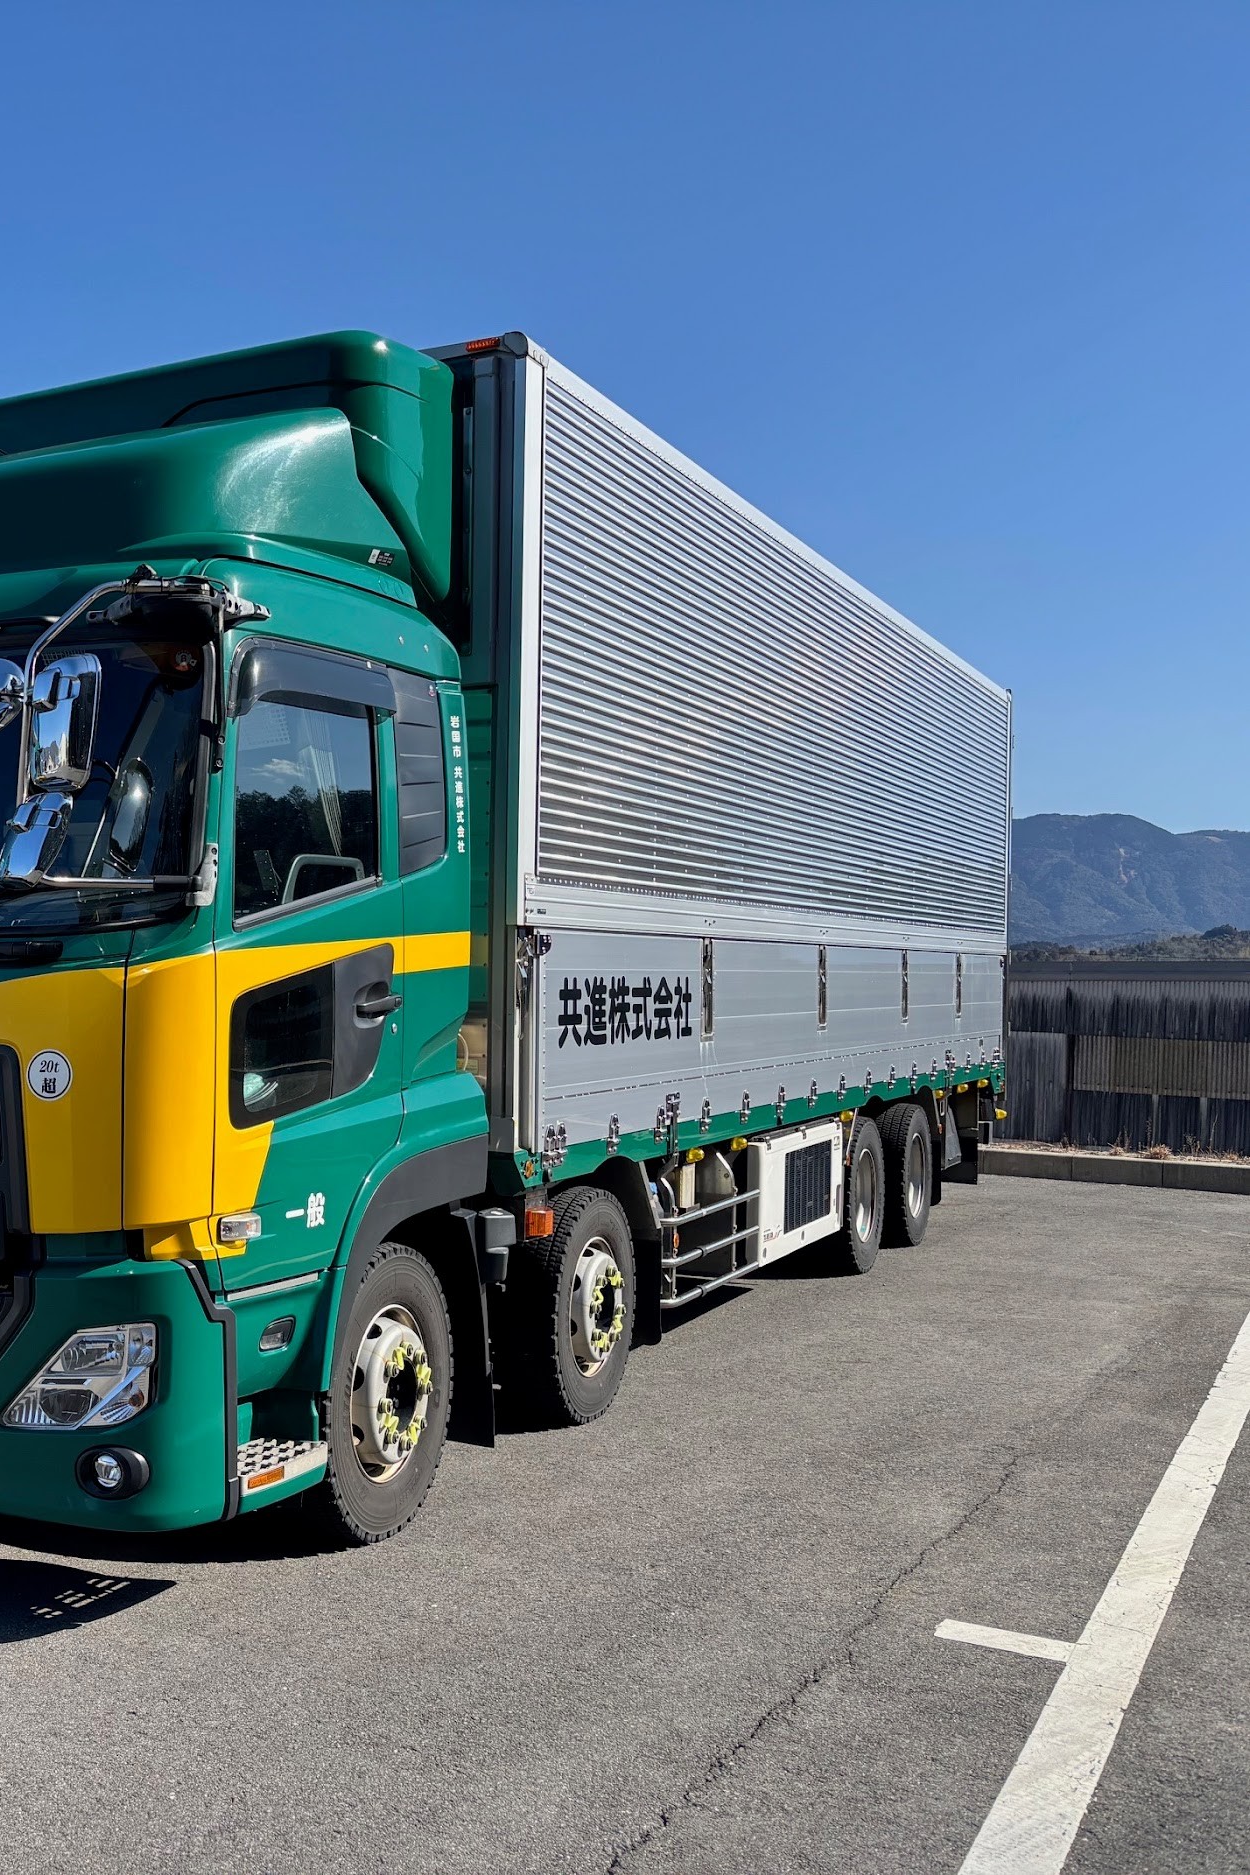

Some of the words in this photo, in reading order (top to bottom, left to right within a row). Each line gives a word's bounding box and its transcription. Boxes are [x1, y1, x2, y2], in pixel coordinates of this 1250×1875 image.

[450, 716, 461, 757] 岩国市
[454, 766, 465, 853] 共進株式会社
[558, 976, 692, 1048] 共進株式会社
[40, 1060, 60, 1073] 20t
[42, 1077, 57, 1093] 超
[285, 1192, 326, 1228] 一般
